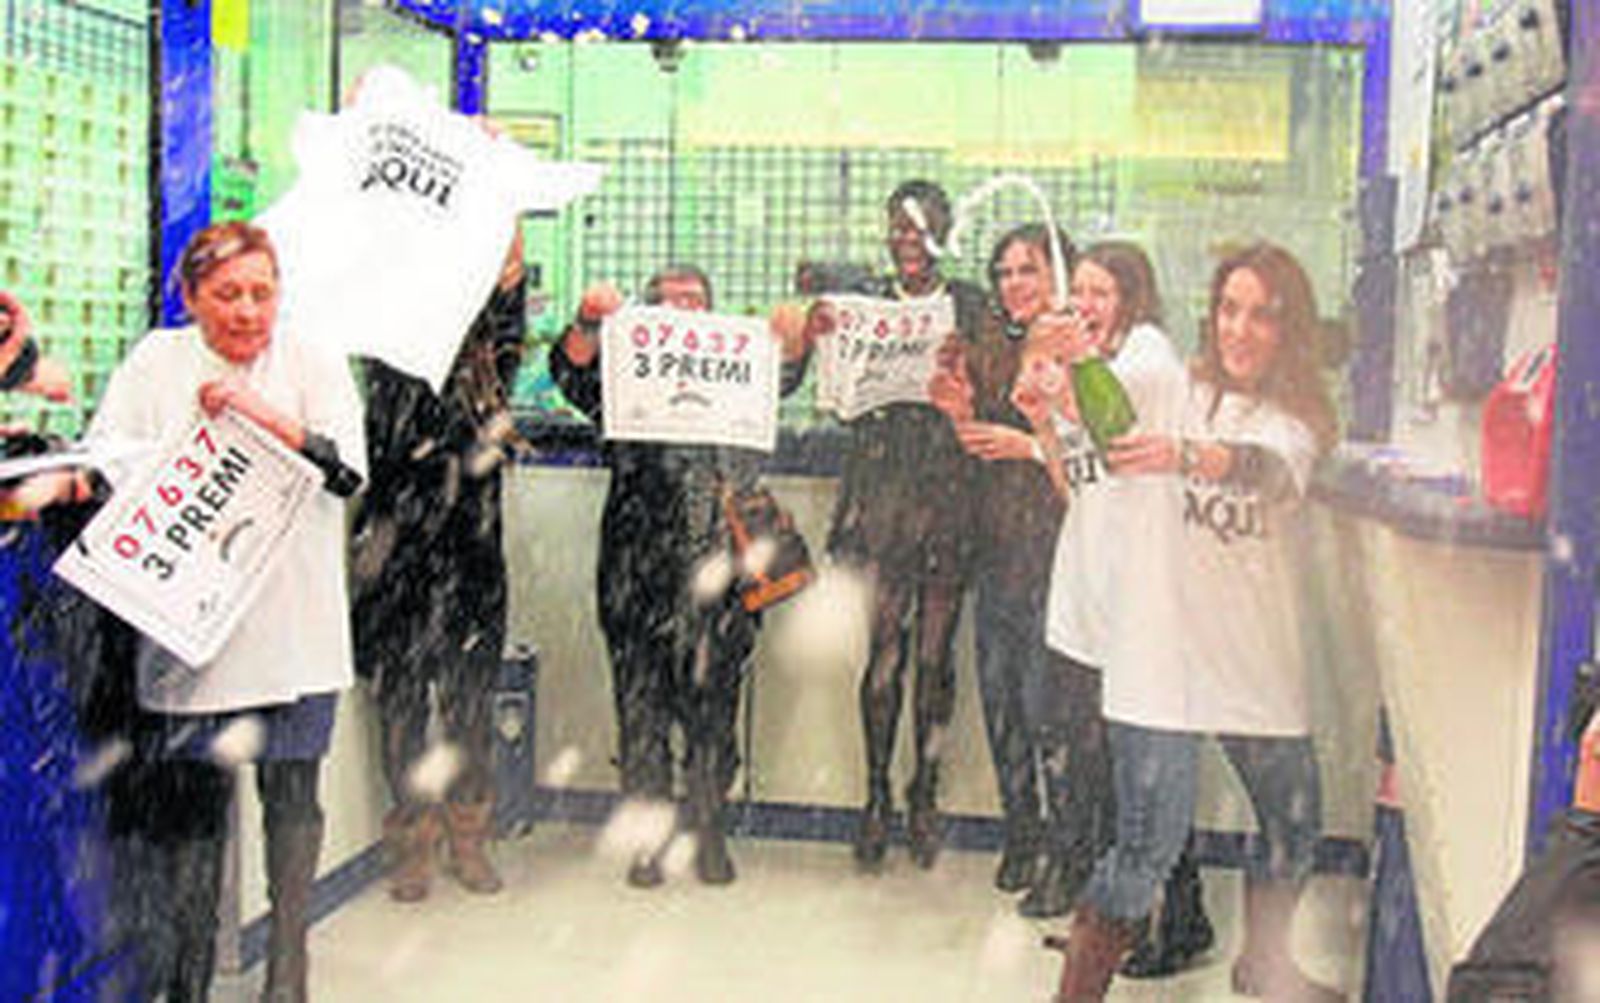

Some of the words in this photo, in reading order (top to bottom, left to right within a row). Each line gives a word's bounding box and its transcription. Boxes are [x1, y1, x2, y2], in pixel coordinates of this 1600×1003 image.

[632, 323, 750, 355] 07637
[634, 352, 651, 379] 3
[659, 352, 751, 384] PREMI
[112, 427, 217, 559] 07637
[142, 552, 175, 582] 3
[165, 446, 252, 553] PREMI
